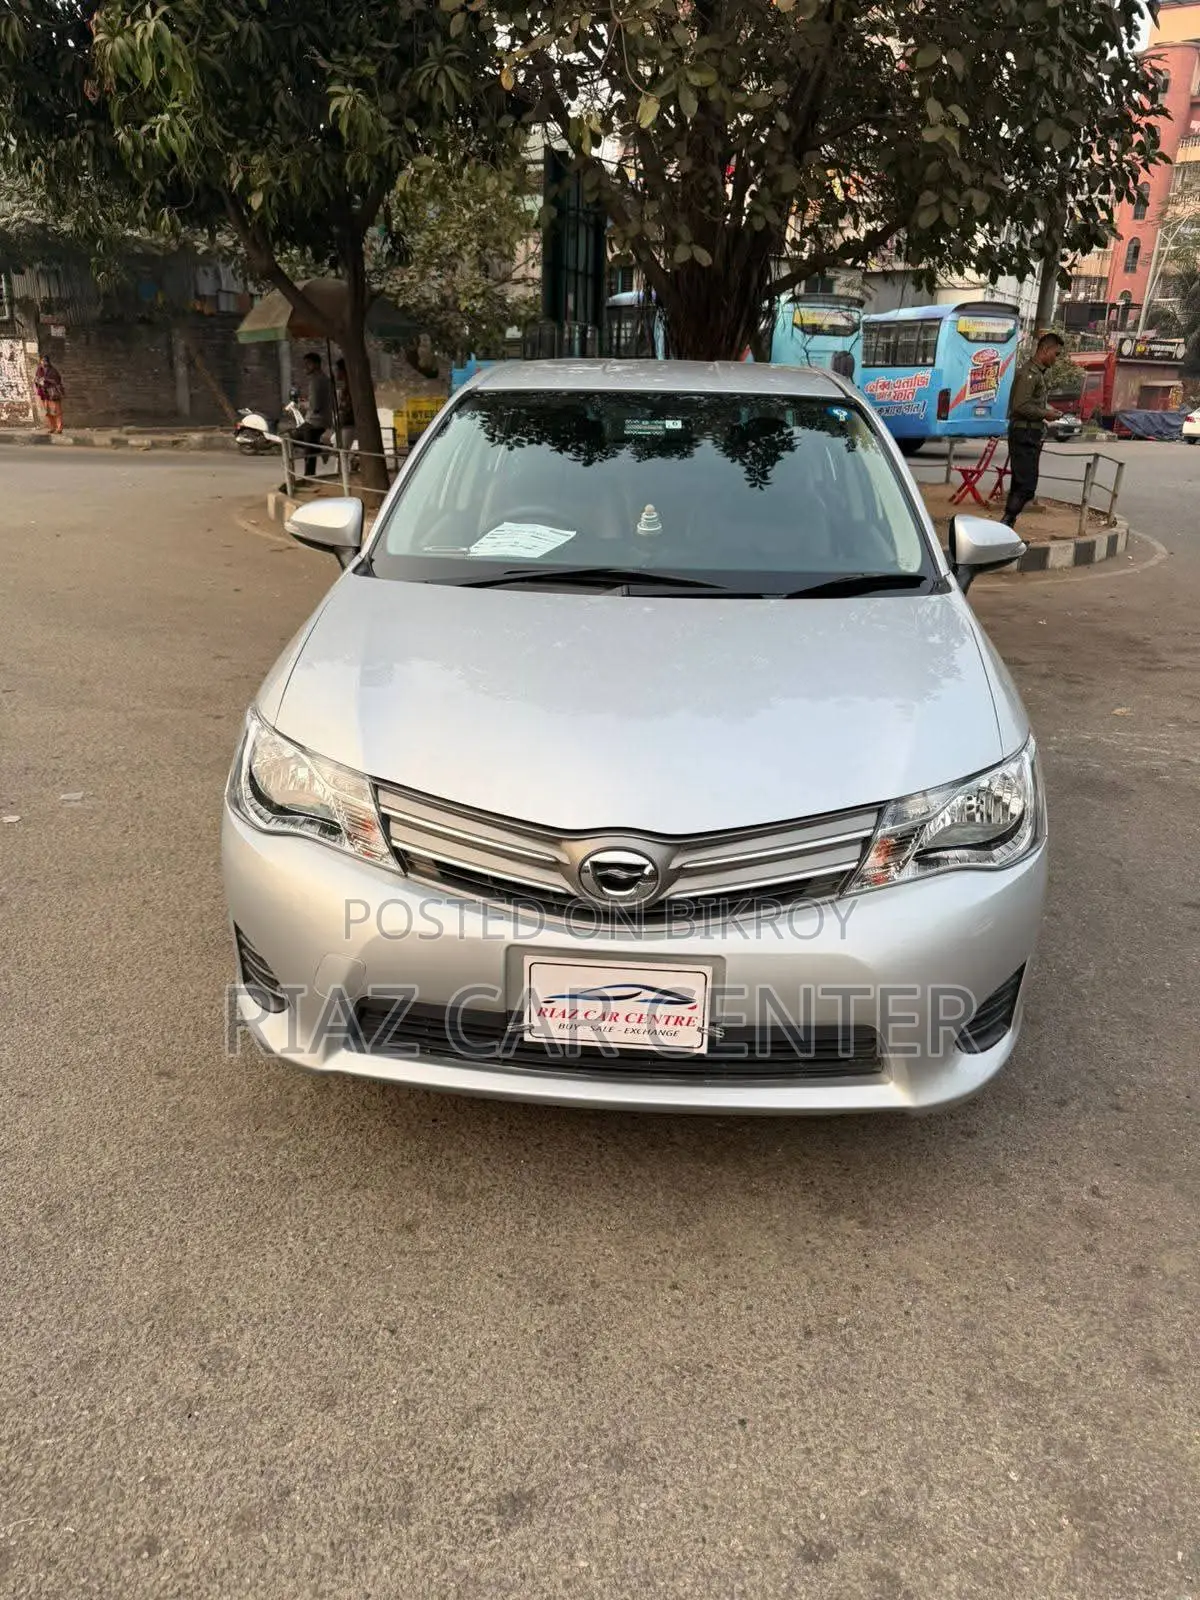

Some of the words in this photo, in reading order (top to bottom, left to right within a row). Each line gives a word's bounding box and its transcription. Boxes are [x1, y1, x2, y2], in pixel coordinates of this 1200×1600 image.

[537, 1006, 580, 1021] RIAZ
[584, 1009, 620, 1023] CAR
[624, 1011, 698, 1028] CENTRE
[558, 1022, 580, 1031] BUY
[590, 1025, 615, 1033] SALE
[624, 1027, 681, 1038] EXCHANGE
